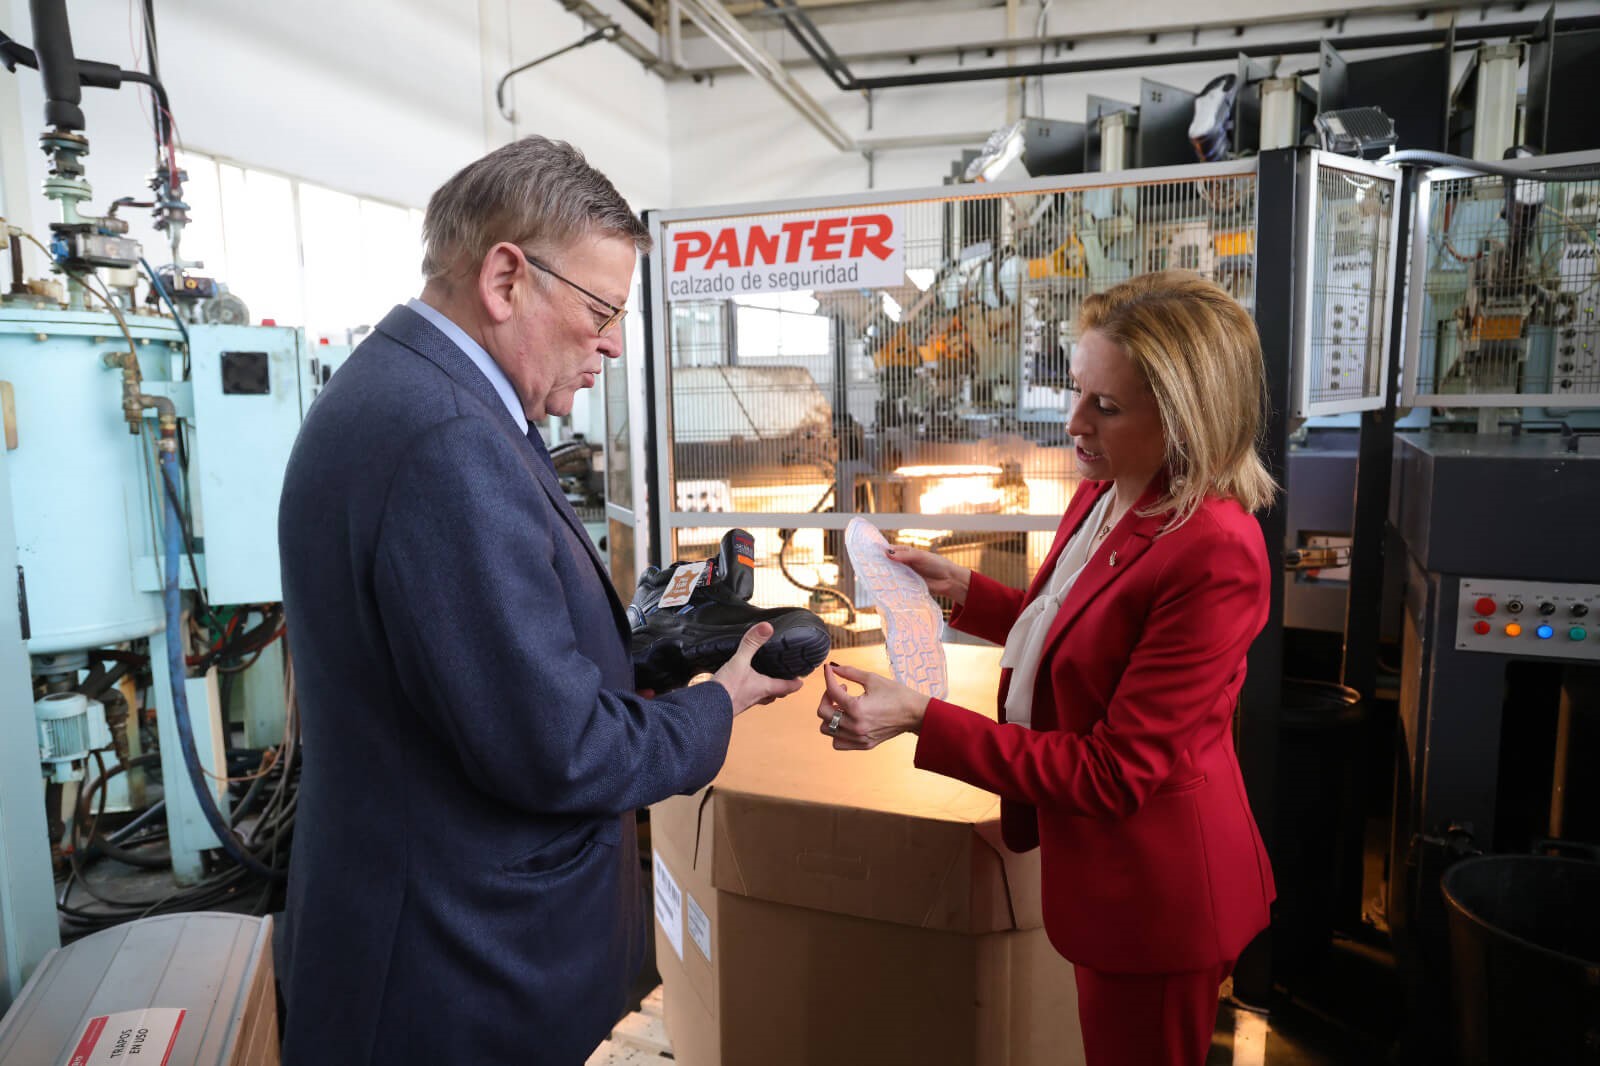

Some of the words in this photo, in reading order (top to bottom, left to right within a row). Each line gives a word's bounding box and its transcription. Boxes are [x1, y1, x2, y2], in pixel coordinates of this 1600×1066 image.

[673, 214, 895, 272] PANTER
[670, 273, 735, 296] calzado
[741, 271, 762, 290] de
[768, 262, 859, 291] seguridad
[110, 1029, 132, 1059] TRAPOS
[129, 1044, 142, 1055] EN
[135, 1028, 149, 1043] USO
